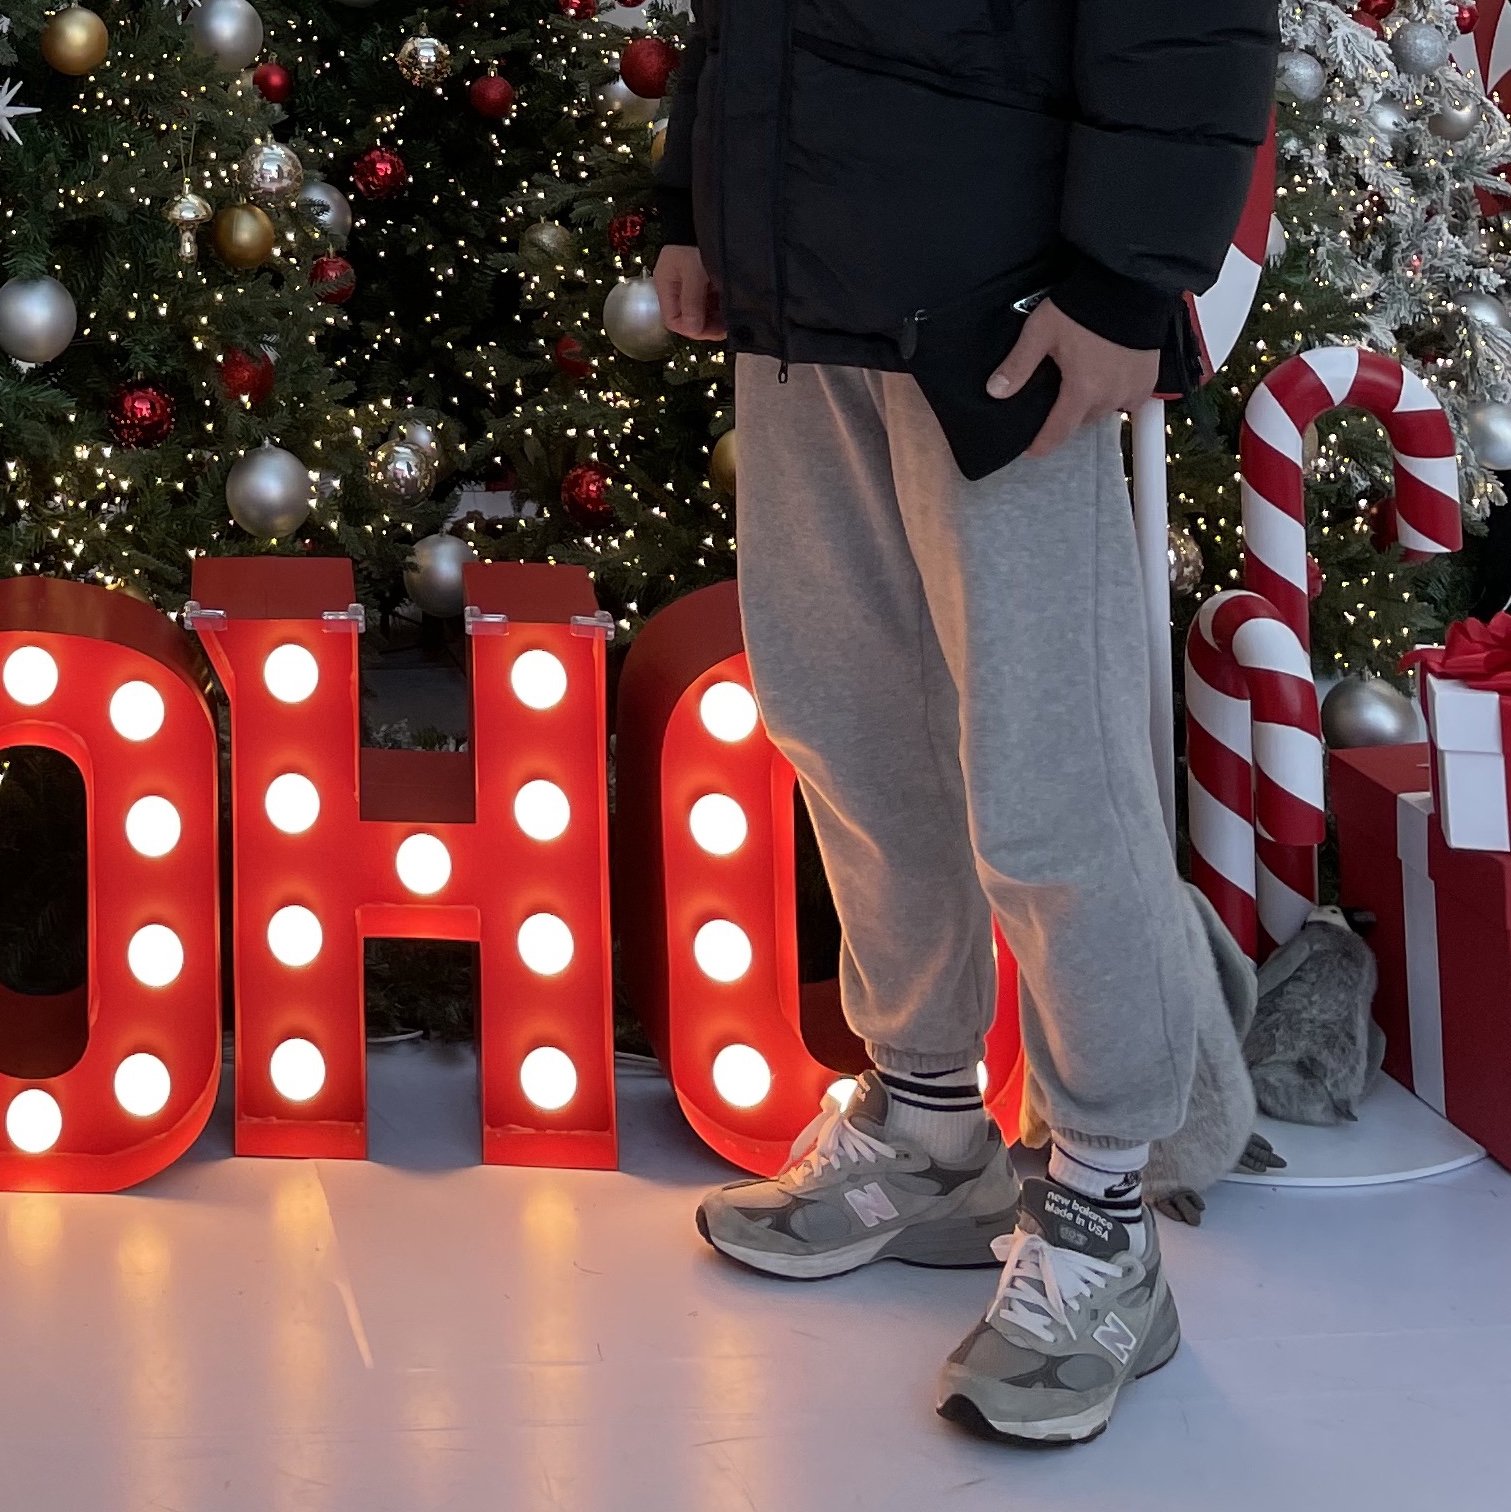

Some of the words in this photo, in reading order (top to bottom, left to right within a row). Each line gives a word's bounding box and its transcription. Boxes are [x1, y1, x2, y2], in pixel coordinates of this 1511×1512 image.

[1044, 1199, 1074, 1221] Made
[1075, 1213, 1086, 1227] in
[1087, 1220, 1109, 1242] USA
[1047, 1191, 1071, 1206] new
[1071, 1199, 1114, 1231] balance
